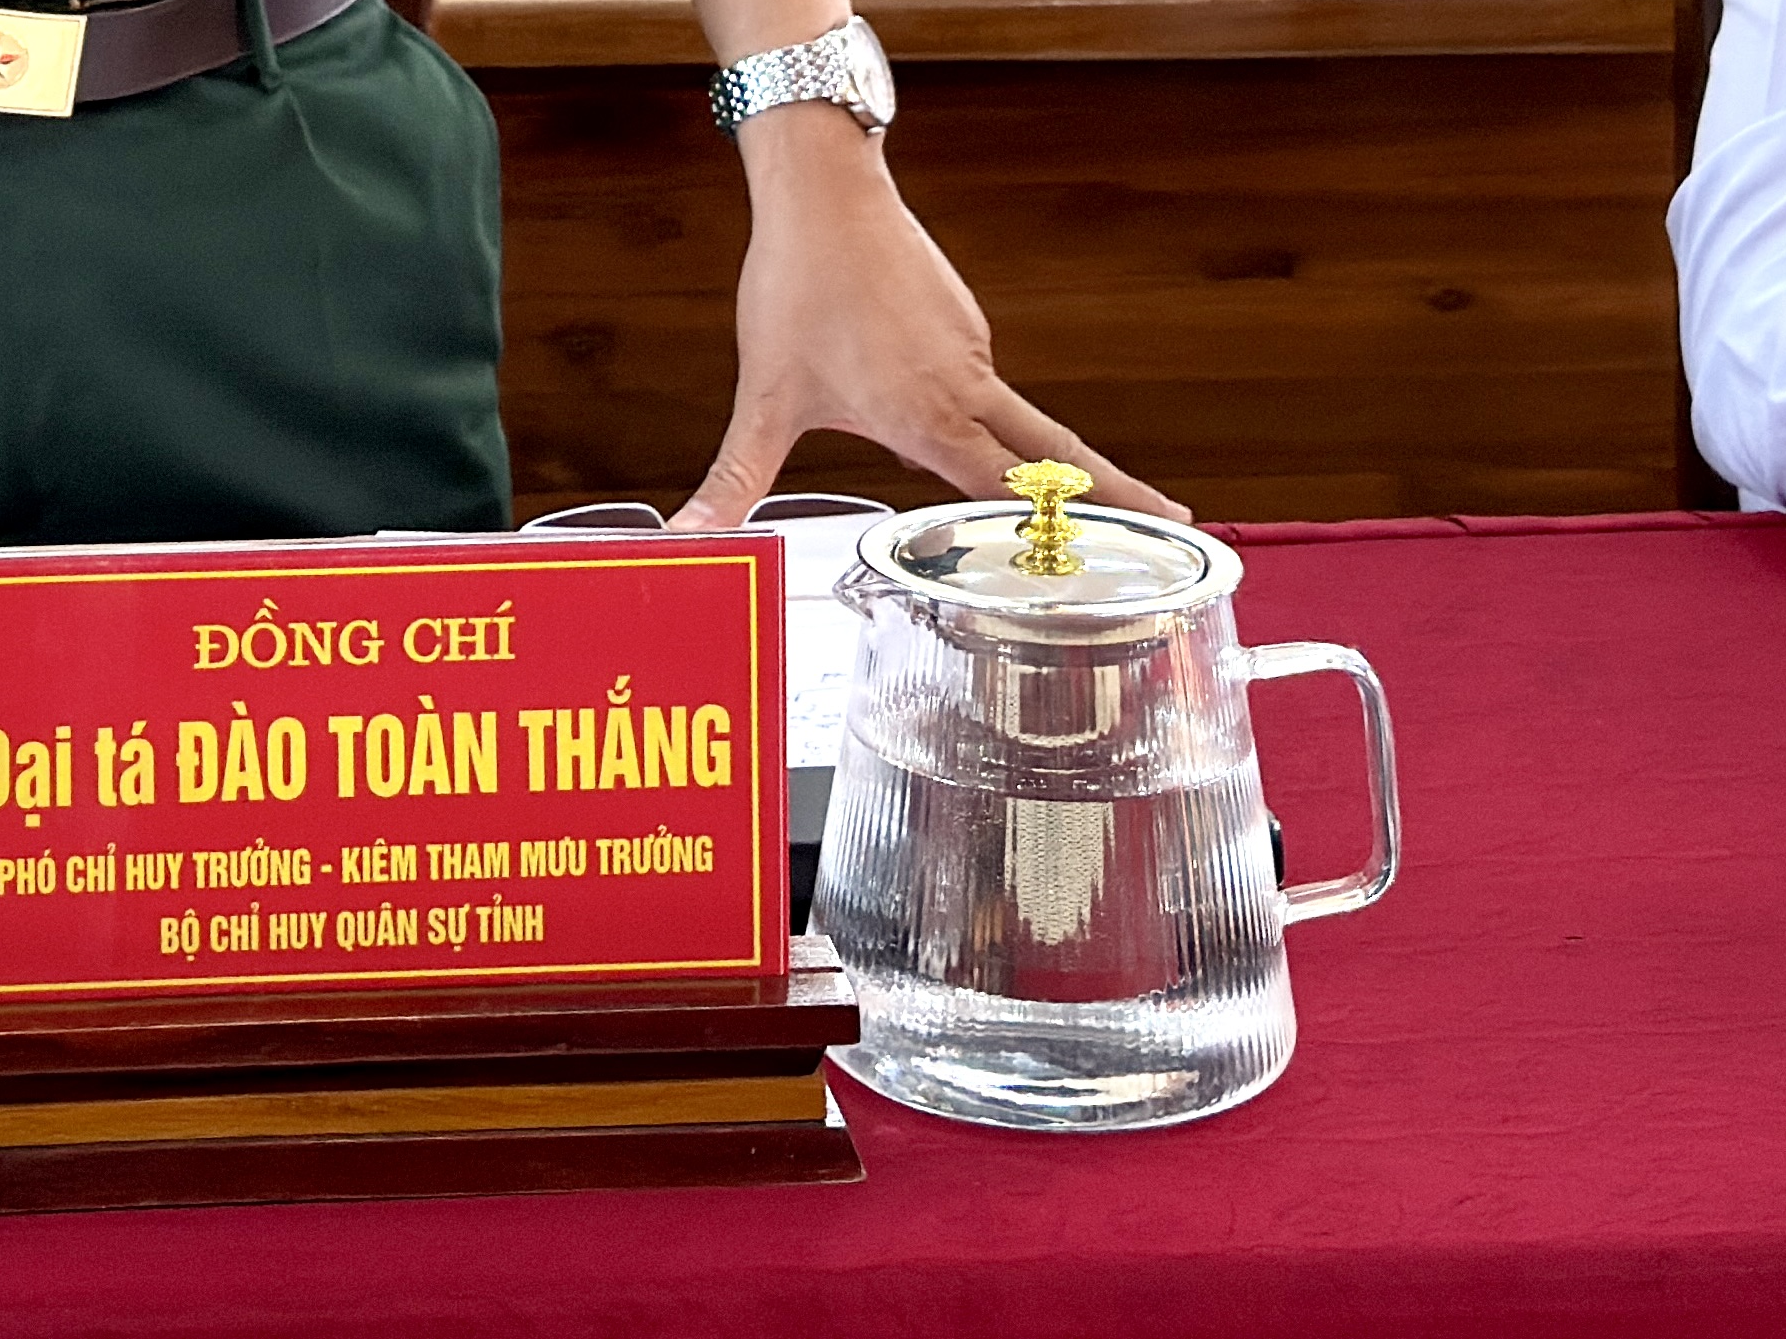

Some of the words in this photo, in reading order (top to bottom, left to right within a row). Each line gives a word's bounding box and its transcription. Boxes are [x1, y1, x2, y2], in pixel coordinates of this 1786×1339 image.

[194, 598, 384, 669] ĐỒNG
[403, 601, 515, 663] CHÍ
[94, 721, 154, 807] tá
[176, 701, 306, 803] ĐÀO
[328, 695, 497, 797] TOÀN
[518, 676, 731, 791] THẮNG
[66, 844, 115, 893] CHỈ
[126, 853, 183, 890] HUY
[193, 838, 311, 888] TRƯỞNG
[342, 838, 417, 883] KIÊM
[426, 842, 509, 880] THAM
[521, 837, 586, 877] MƯU
[596, 826, 713, 875] TRƯỞNG
[161, 910, 199, 961] BỘ
[210, 903, 259, 952] CHỈ
[270, 913, 327, 950] HUY
[337, 902, 417, 951] QUÂN
[428, 904, 470, 951] SỰ
[476, 895, 543, 942] TỈNH
